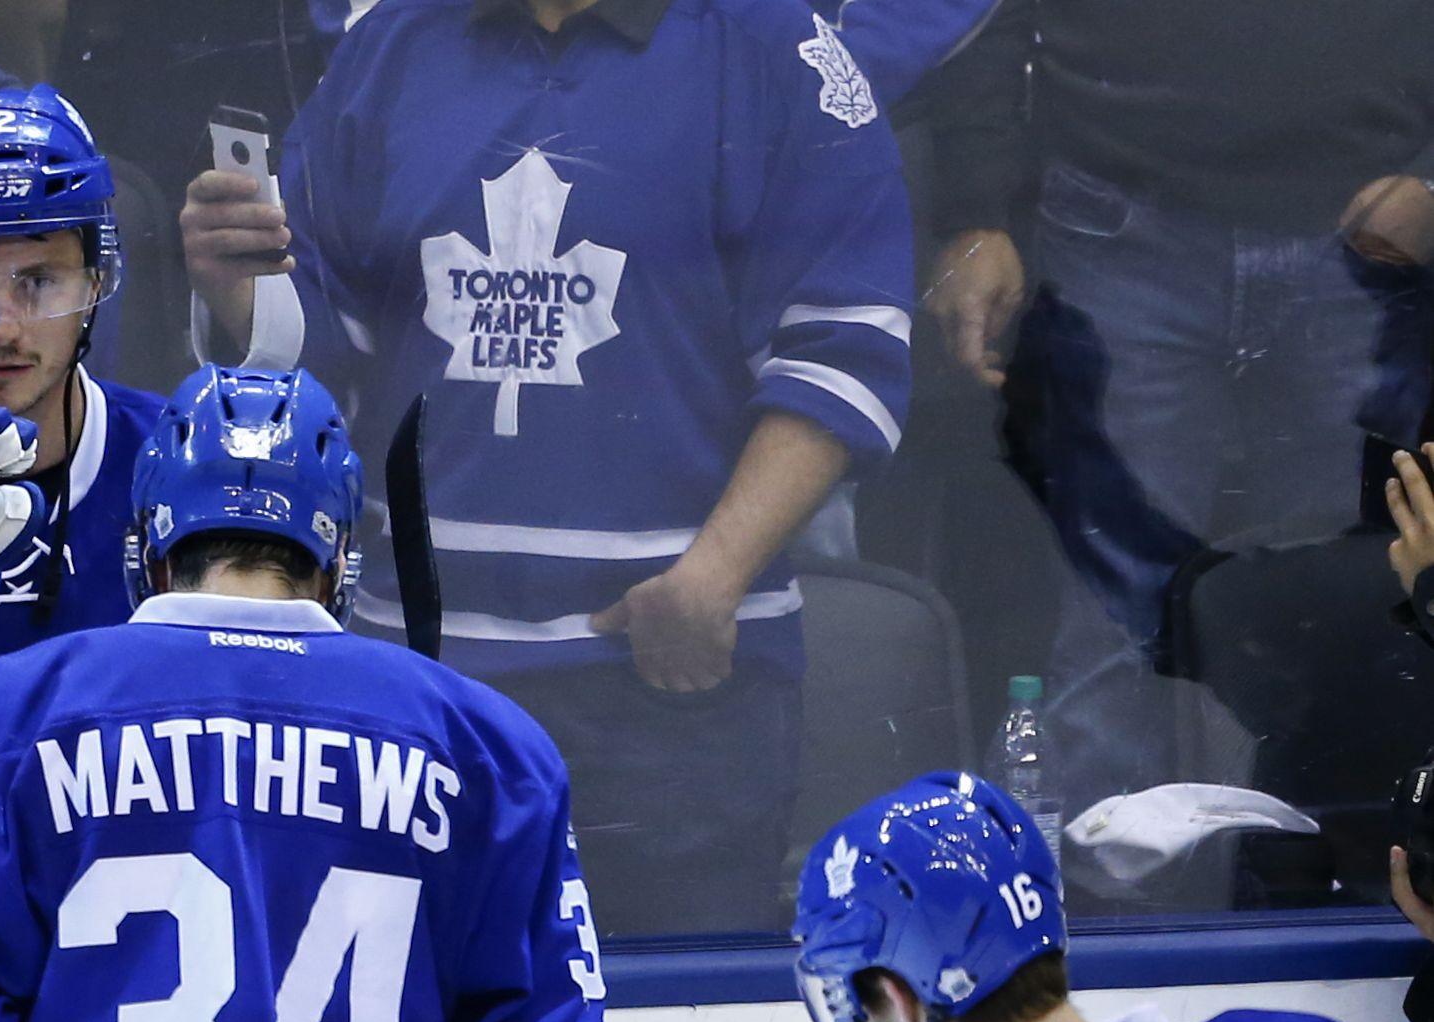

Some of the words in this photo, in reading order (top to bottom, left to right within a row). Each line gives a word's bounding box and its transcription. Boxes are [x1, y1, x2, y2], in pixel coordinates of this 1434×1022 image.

[448, 268, 596, 305] TORONTO
[468, 302, 564, 338] MAPLE
[471, 335, 559, 371] LEAFS
[208, 630, 306, 656] Reebok
[35, 716, 463, 853] MATTHEWS
[998, 872, 1044, 930] 16
